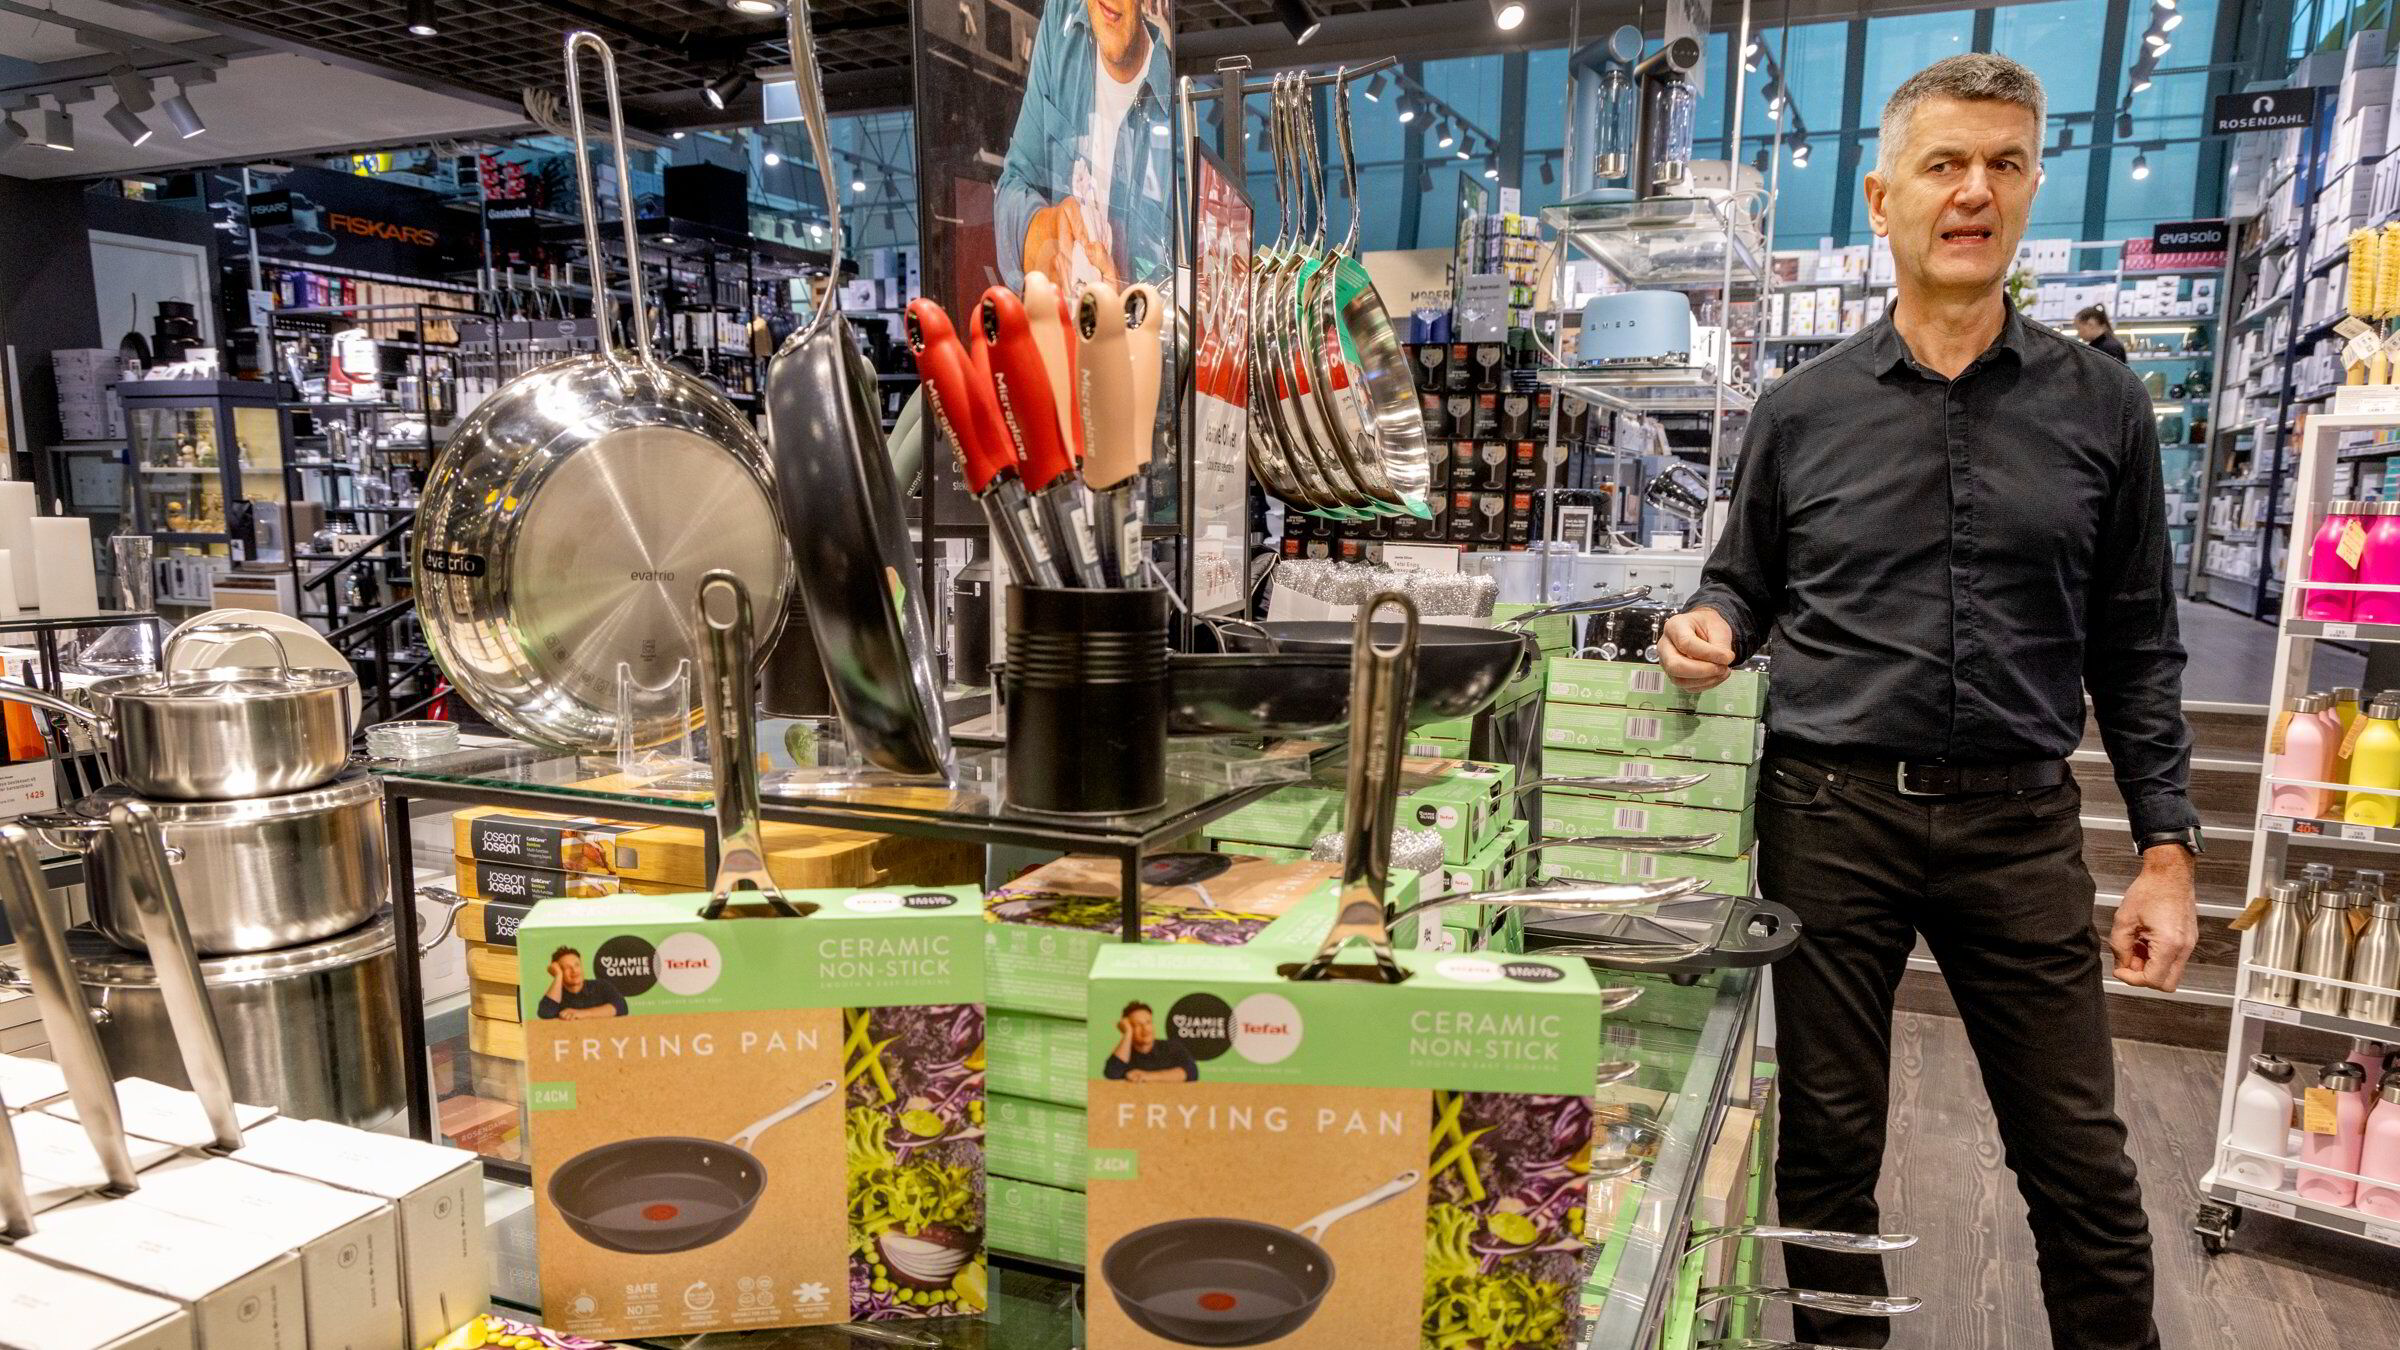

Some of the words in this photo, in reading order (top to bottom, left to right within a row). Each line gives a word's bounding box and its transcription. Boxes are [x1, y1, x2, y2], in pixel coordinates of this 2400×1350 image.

[2219, 114, 2305, 130] ROSENDAHL
[251, 202, 288, 215] FISKARS
[329, 212, 435, 247] FISKARS
[1411, 290, 1451, 301] MODER
[995, 372, 1028, 462] Microplane
[1080, 369, 1096, 458] Microplane
[926, 379, 968, 465] Microplane
[631, 569, 675, 583] evatrio
[25, 790, 45, 800] 1429
[482, 830, 521, 845] Joseph
[482, 841, 521, 854] Joseph
[488, 871, 526, 885] Joseph
[488, 881, 526, 895] Joseph
[496, 915, 520, 928] Jose
[496, 925, 519, 937] Jose
[819, 935, 951, 959] CERAMIC
[612, 956, 649, 967] JAMIE
[664, 958, 709, 971] Tefal
[819, 957, 951, 980] NON-STICK
[606, 966, 650, 977] OLIVER
[1184, 1016, 1224, 1028] JAMIE
[1243, 1021, 1289, 1036] Tefal
[1410, 1011, 1560, 1038] CERAMIC
[1178, 1026, 1225, 1039] OLIVER
[553, 1033, 715, 1062] FRYING
[741, 1028, 818, 1054] PAN
[1410, 1037, 1559, 1060] NON-STICK
[534, 1091, 568, 1104] 24CM
[1118, 1103, 1288, 1132] FRYING
[1317, 1108, 1403, 1136] PAN
[1094, 1157, 1130, 1172] 24CM
[626, 1283, 658, 1295] SAFE
[627, 1305, 643, 1316] NO
